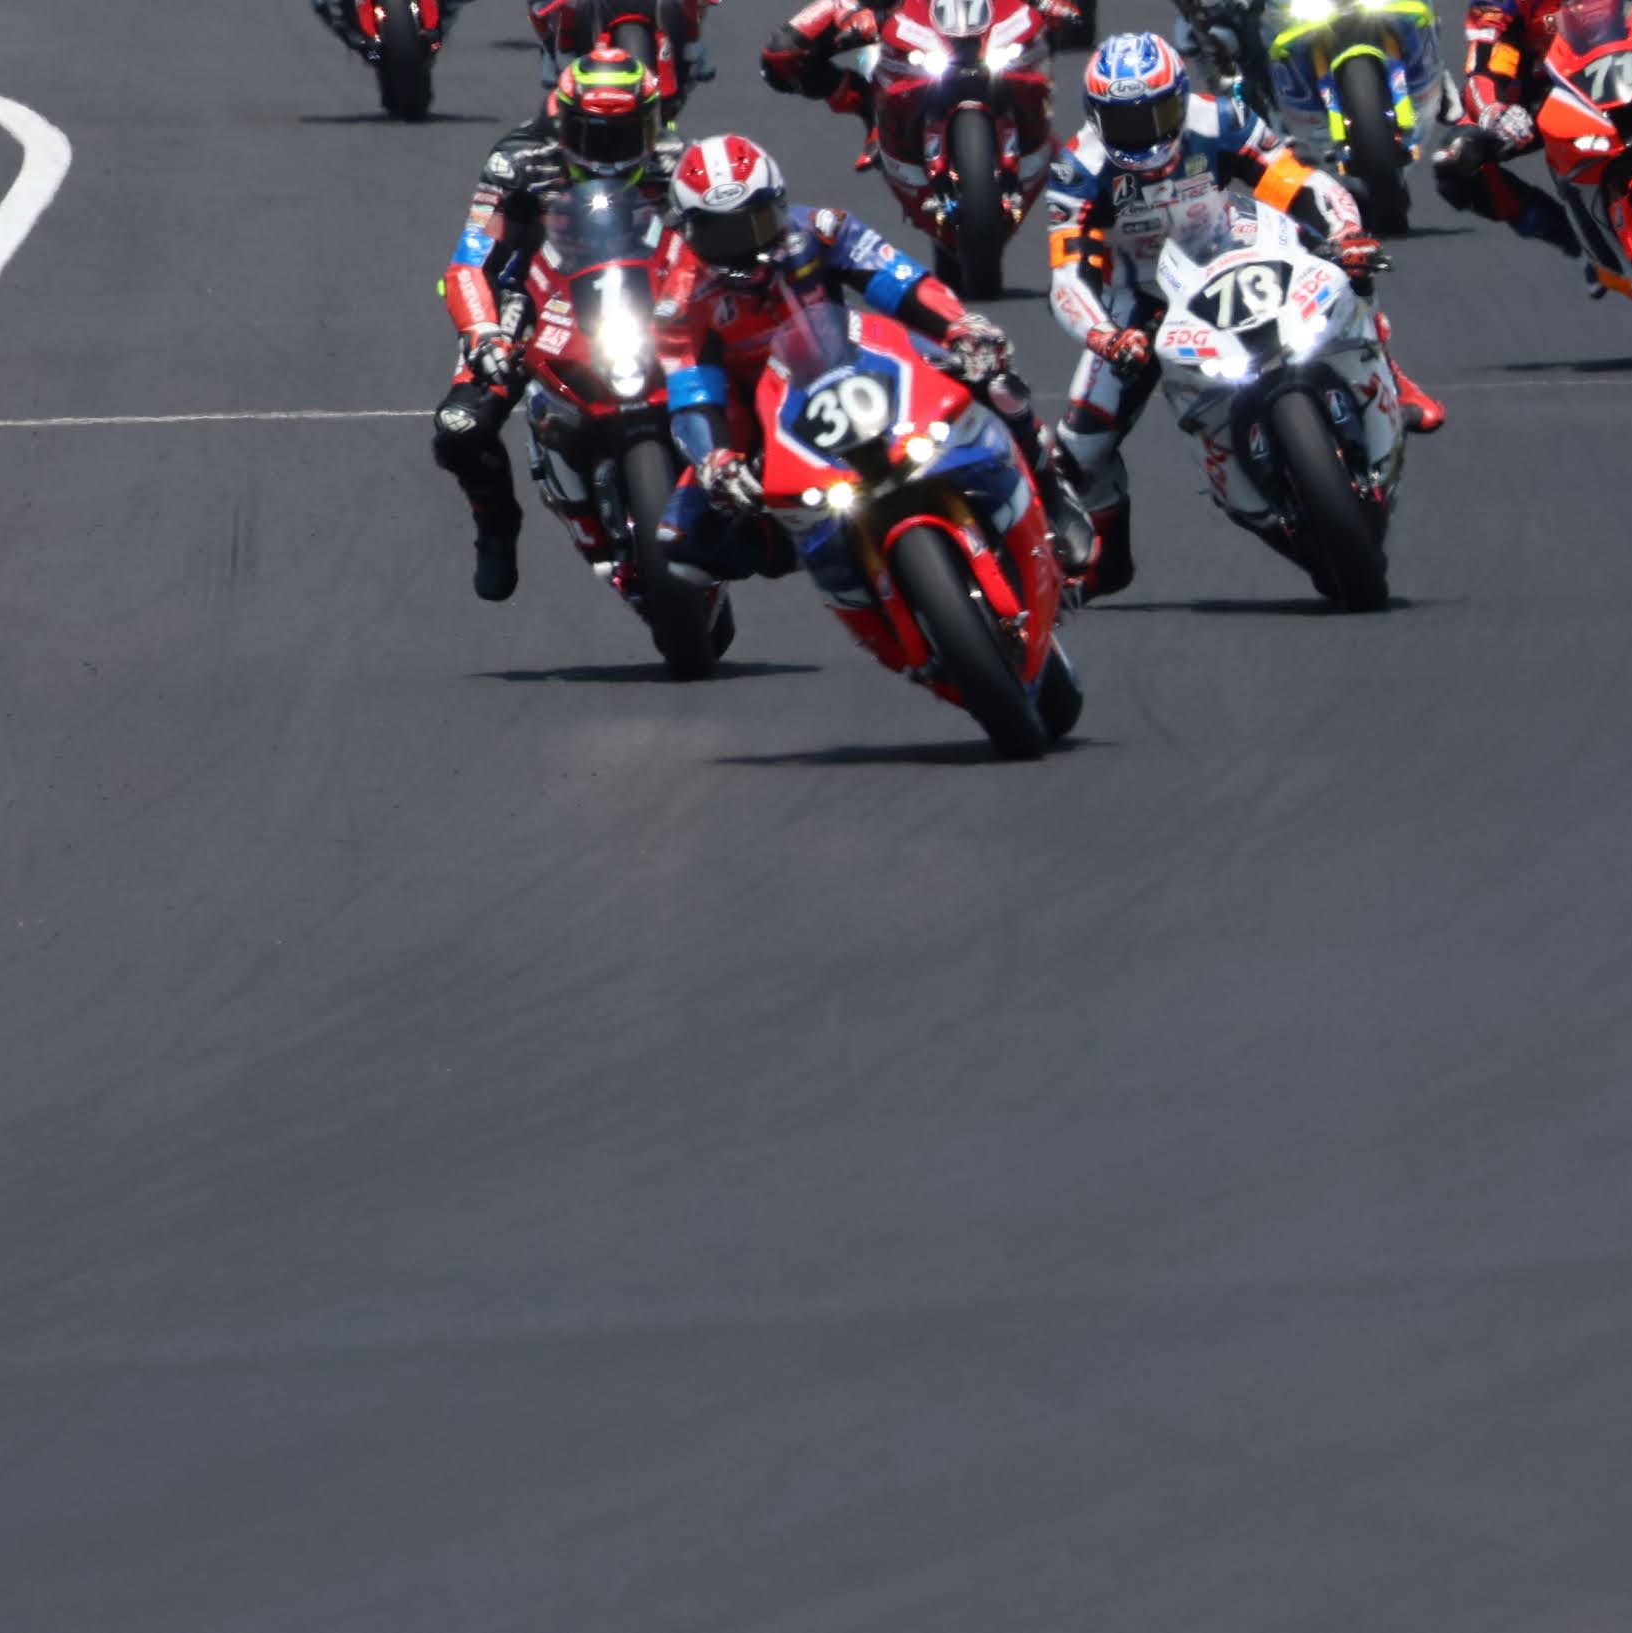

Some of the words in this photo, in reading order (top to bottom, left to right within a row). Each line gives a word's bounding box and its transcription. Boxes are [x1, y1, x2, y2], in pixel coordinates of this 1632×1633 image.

[1203, 264, 1283, 329] 73
[1290, 268, 1333, 305] SDG
[1162, 329, 1213, 347] SDG
[806, 375, 890, 448] 30
